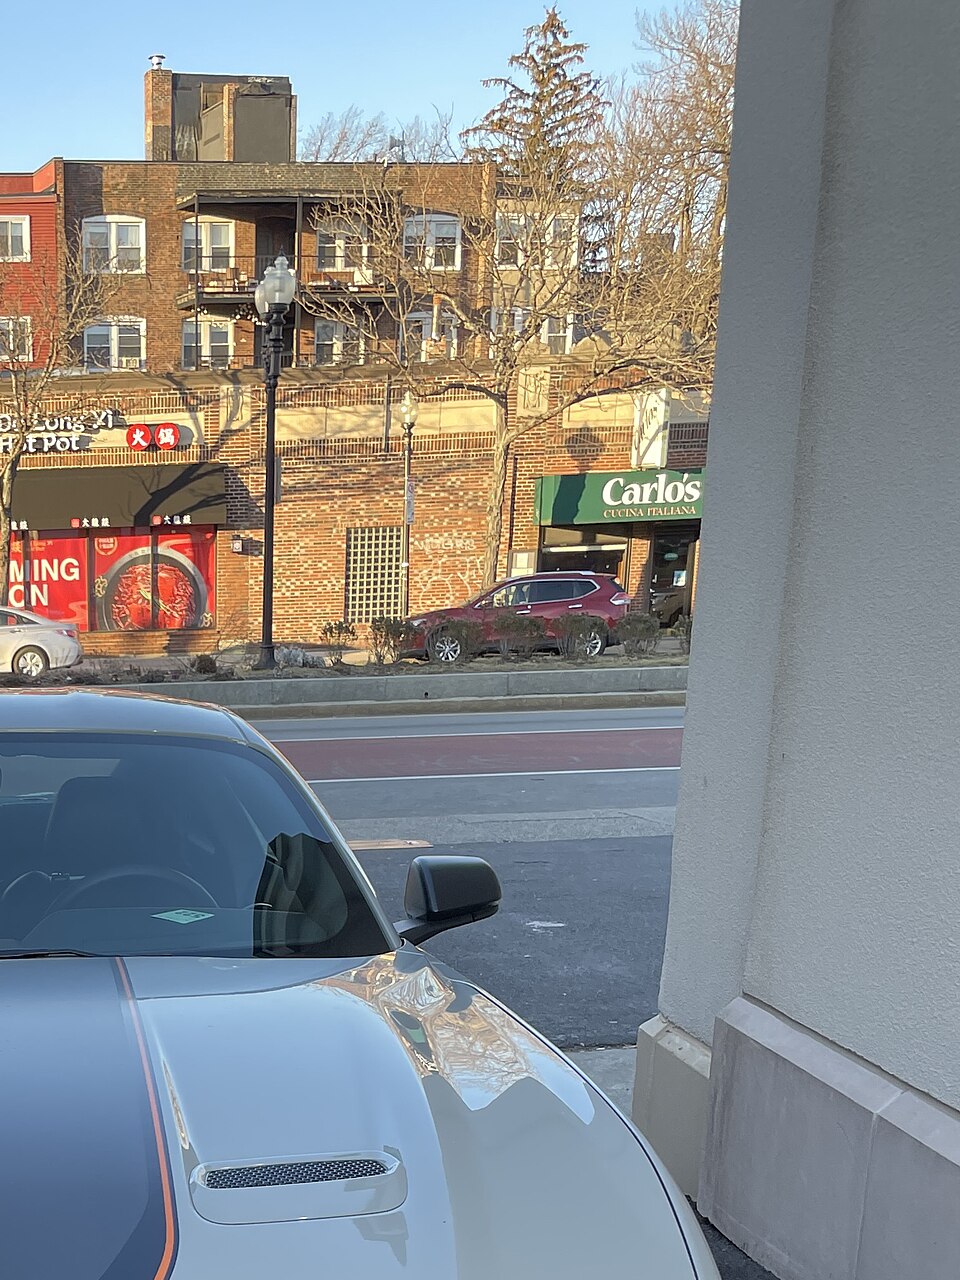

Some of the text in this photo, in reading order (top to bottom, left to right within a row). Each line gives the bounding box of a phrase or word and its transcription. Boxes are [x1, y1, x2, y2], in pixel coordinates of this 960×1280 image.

[43, 432, 80, 453] Pot
[602, 472, 701, 506] Carlo's
[603, 505, 697, 518] CUCINA ITALIANA
